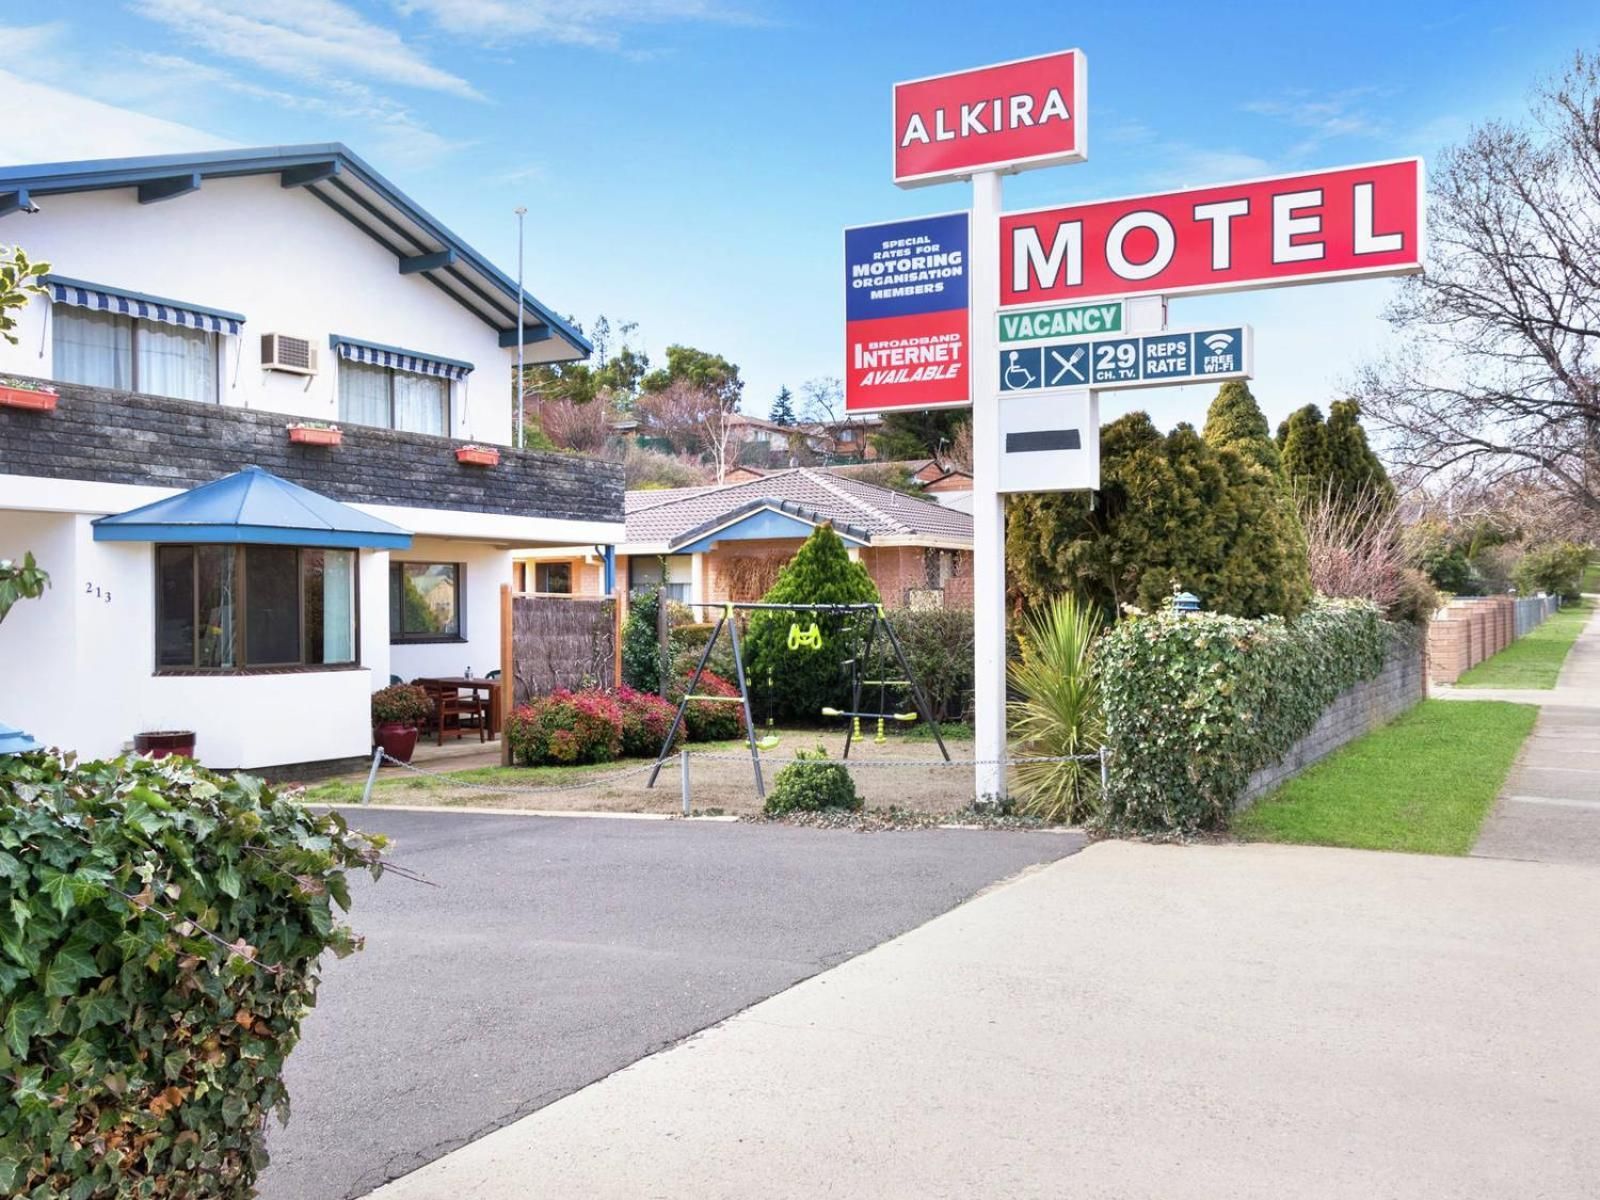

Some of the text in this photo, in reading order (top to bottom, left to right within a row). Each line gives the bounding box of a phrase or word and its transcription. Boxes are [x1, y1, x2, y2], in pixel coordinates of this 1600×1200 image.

[900, 87, 1071, 147] ALKIRA
[883, 236, 930, 249] SPECIAL
[1011, 181, 1405, 292] MOTEL
[873, 244, 940, 260] RATES FOR
[852, 251, 962, 277] MOTORING
[852, 266, 963, 289] ORGANISATION
[870, 282, 944, 300] MEMBERS
[1002, 306, 1117, 339] VACANCY
[868, 333, 961, 350] BROADBAND
[1147, 341, 1187, 358] REPS
[1096, 343, 1137, 370] 29
[1147, 357, 1187, 374] RATE
[1203, 354, 1234, 365] FREE
[860, 363, 961, 387] AVAILABLE
[1096, 368, 1137, 381] CH. TV.
[85, 581, 112, 603] 213
